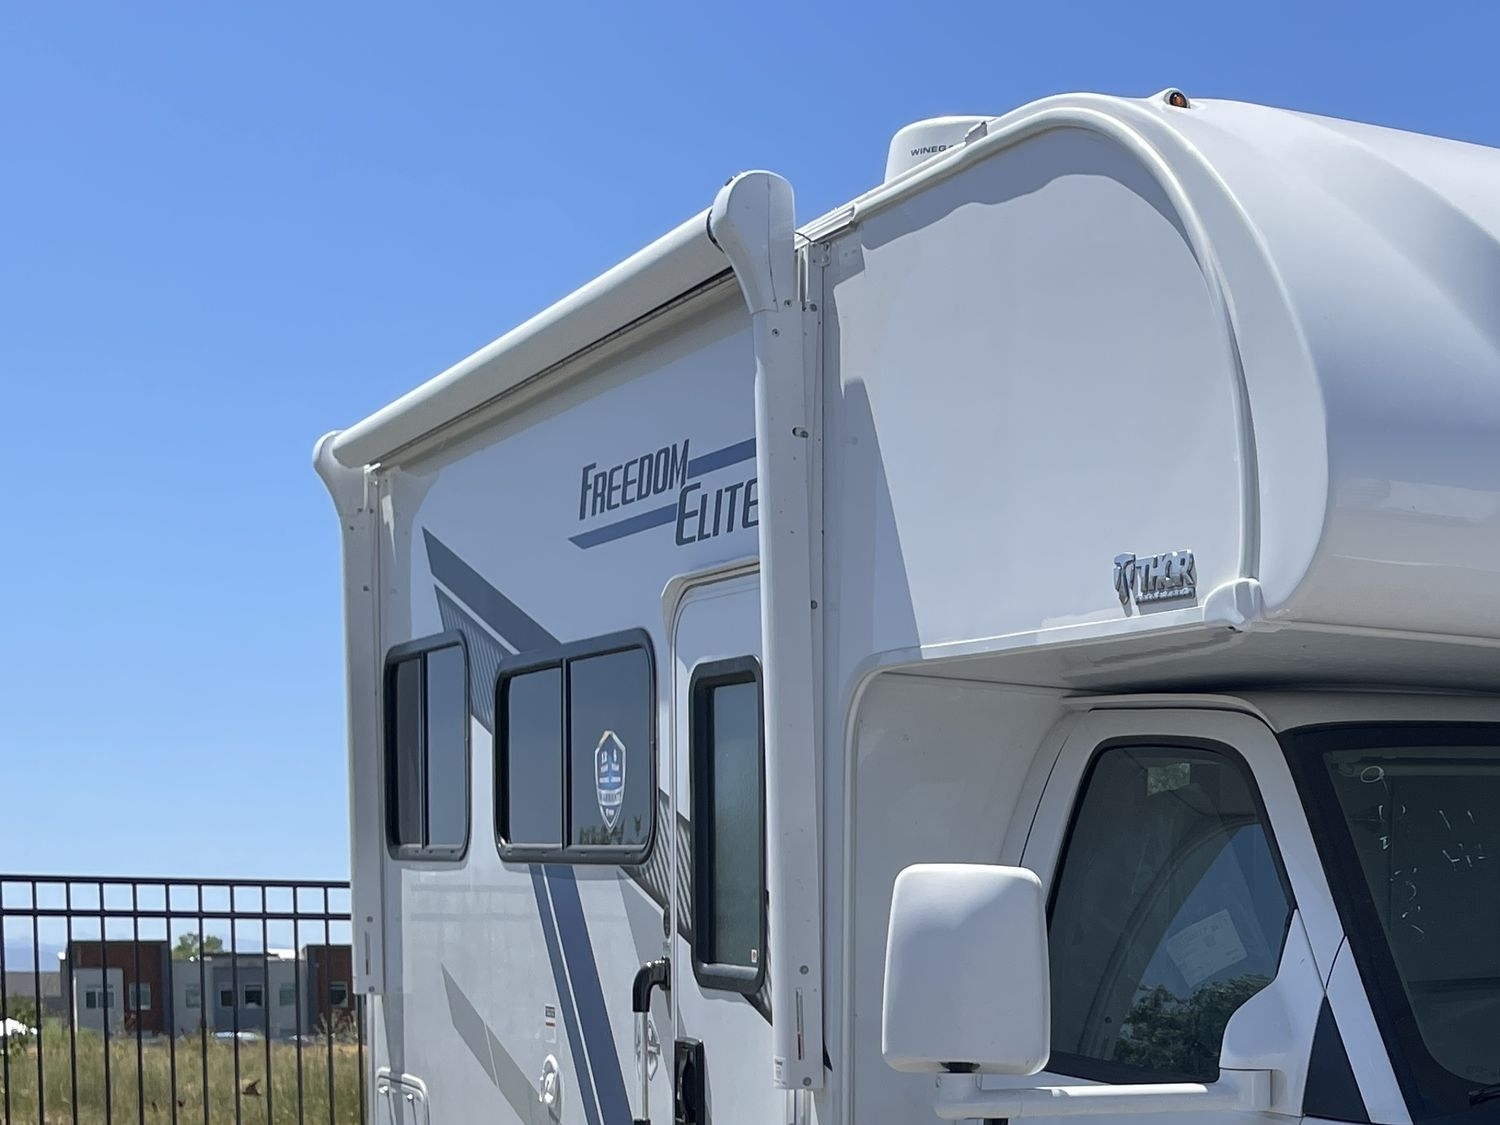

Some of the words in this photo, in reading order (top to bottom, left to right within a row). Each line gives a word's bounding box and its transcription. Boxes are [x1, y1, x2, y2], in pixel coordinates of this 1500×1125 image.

[910, 144, 954, 157] WINEG
[579, 438, 690, 521] FREEDOM
[675, 477, 760, 547] ELITE
[1135, 549, 1196, 594] THOR
